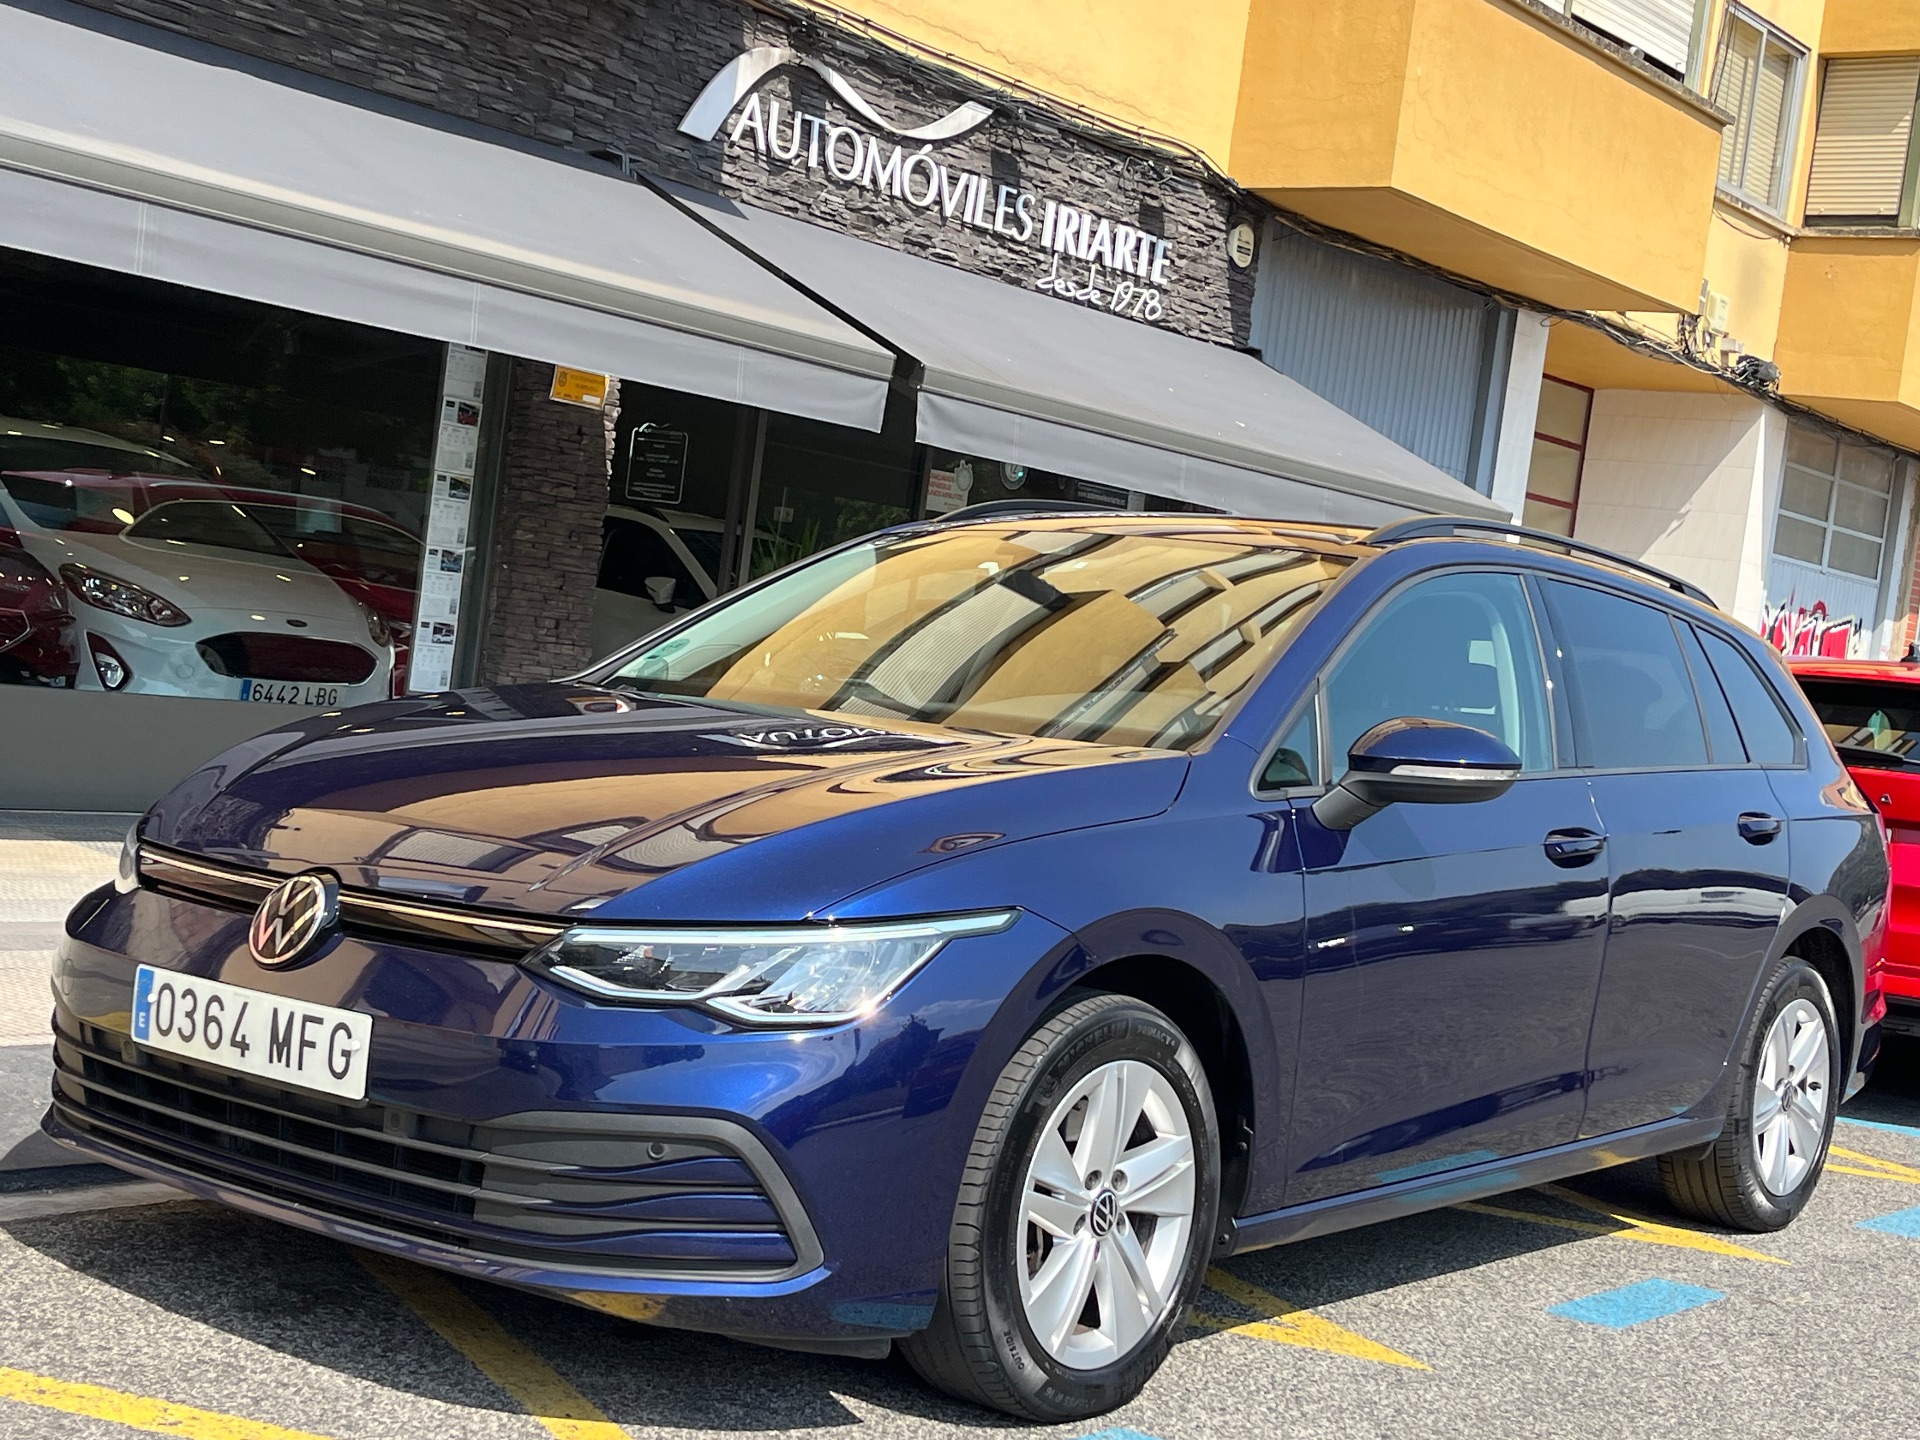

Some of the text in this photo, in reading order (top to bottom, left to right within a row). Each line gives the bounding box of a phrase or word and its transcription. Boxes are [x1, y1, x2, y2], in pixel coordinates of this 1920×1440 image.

[729, 92, 1173, 286] AUTOMÓVILES IRIARTE
[1036, 253, 1162, 321] desde 1978
[252, 683, 338, 706] 6442 LBG
[139, 1012, 146, 1028] E
[155, 982, 352, 1080] 0364 MFG
[1003, 1329, 1025, 1370] OUTSIDE
